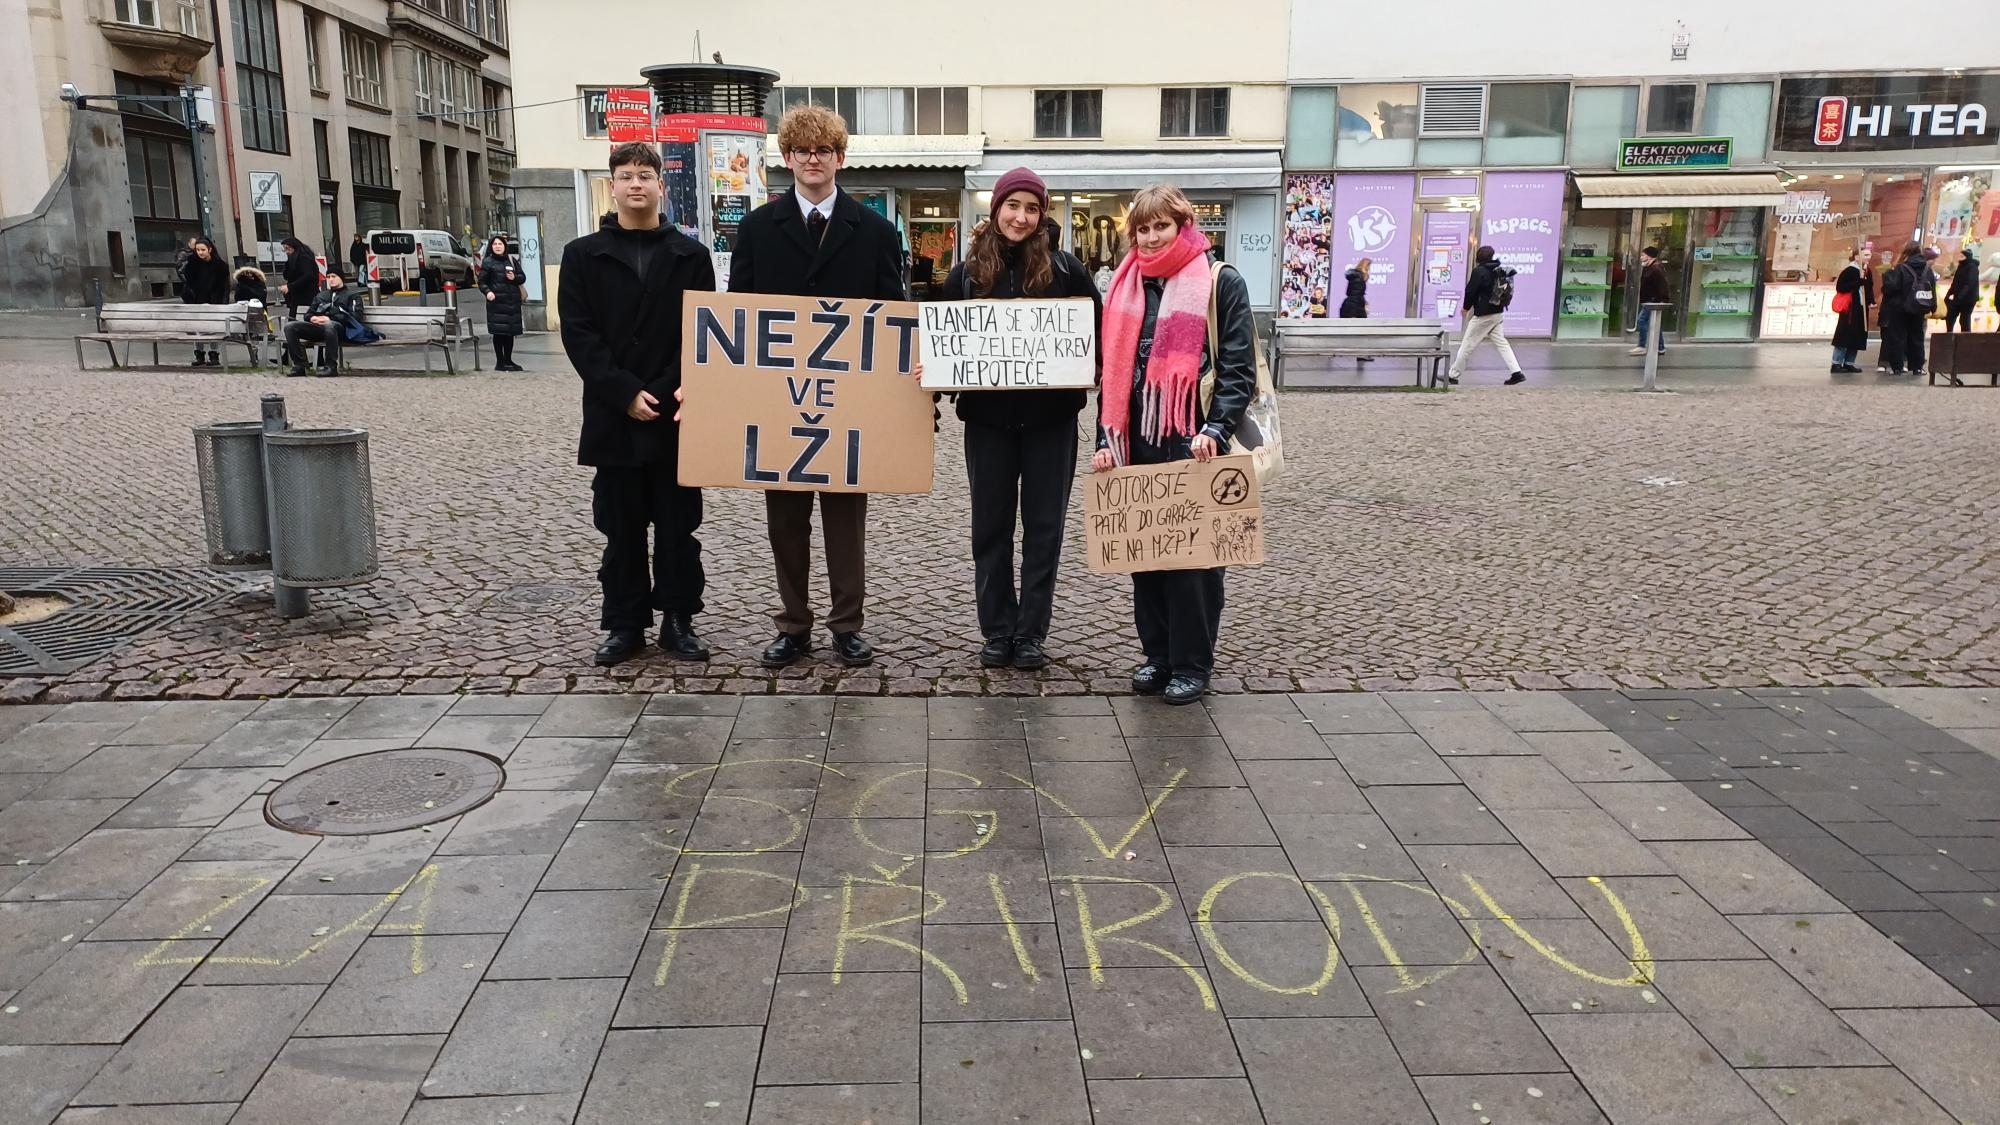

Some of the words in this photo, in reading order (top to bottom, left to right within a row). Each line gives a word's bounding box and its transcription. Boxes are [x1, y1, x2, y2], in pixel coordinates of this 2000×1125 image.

[1822, 104, 1841, 138] 喜茶
[1849, 105, 1892, 136] HI
[1906, 103, 1987, 136] TEA
[1625, 142, 1727, 156] ELEKTRONICKÉ
[1625, 155, 1689, 165] CIGARETY
[1241, 233, 1271, 246] EGO
[1487, 217, 1552, 235] kspace.
[925, 305, 997, 333] PLANETA
[1005, 307, 1023, 332] SE
[1030, 303, 1078, 333] STÁLE
[695, 299, 919, 374] NEŽÍT
[978, 333, 1051, 358] ZELENÁ
[1054, 334, 1092, 358] KREV
[786, 376, 836, 408] VE
[743, 411, 861, 486] LŽI
[1096, 464, 1189, 511] MOTORISTÉ
[1091, 505, 1132, 536] PATŘÍ
[1136, 507, 1153, 532] DO
[1156, 499, 1205, 527] GARÁŽE
[1102, 540, 1120, 567] NE
[1126, 538, 1144, 563] NA
[1152, 527, 1199, 559] MŽP!
[133, 863, 440, 975] ZA
